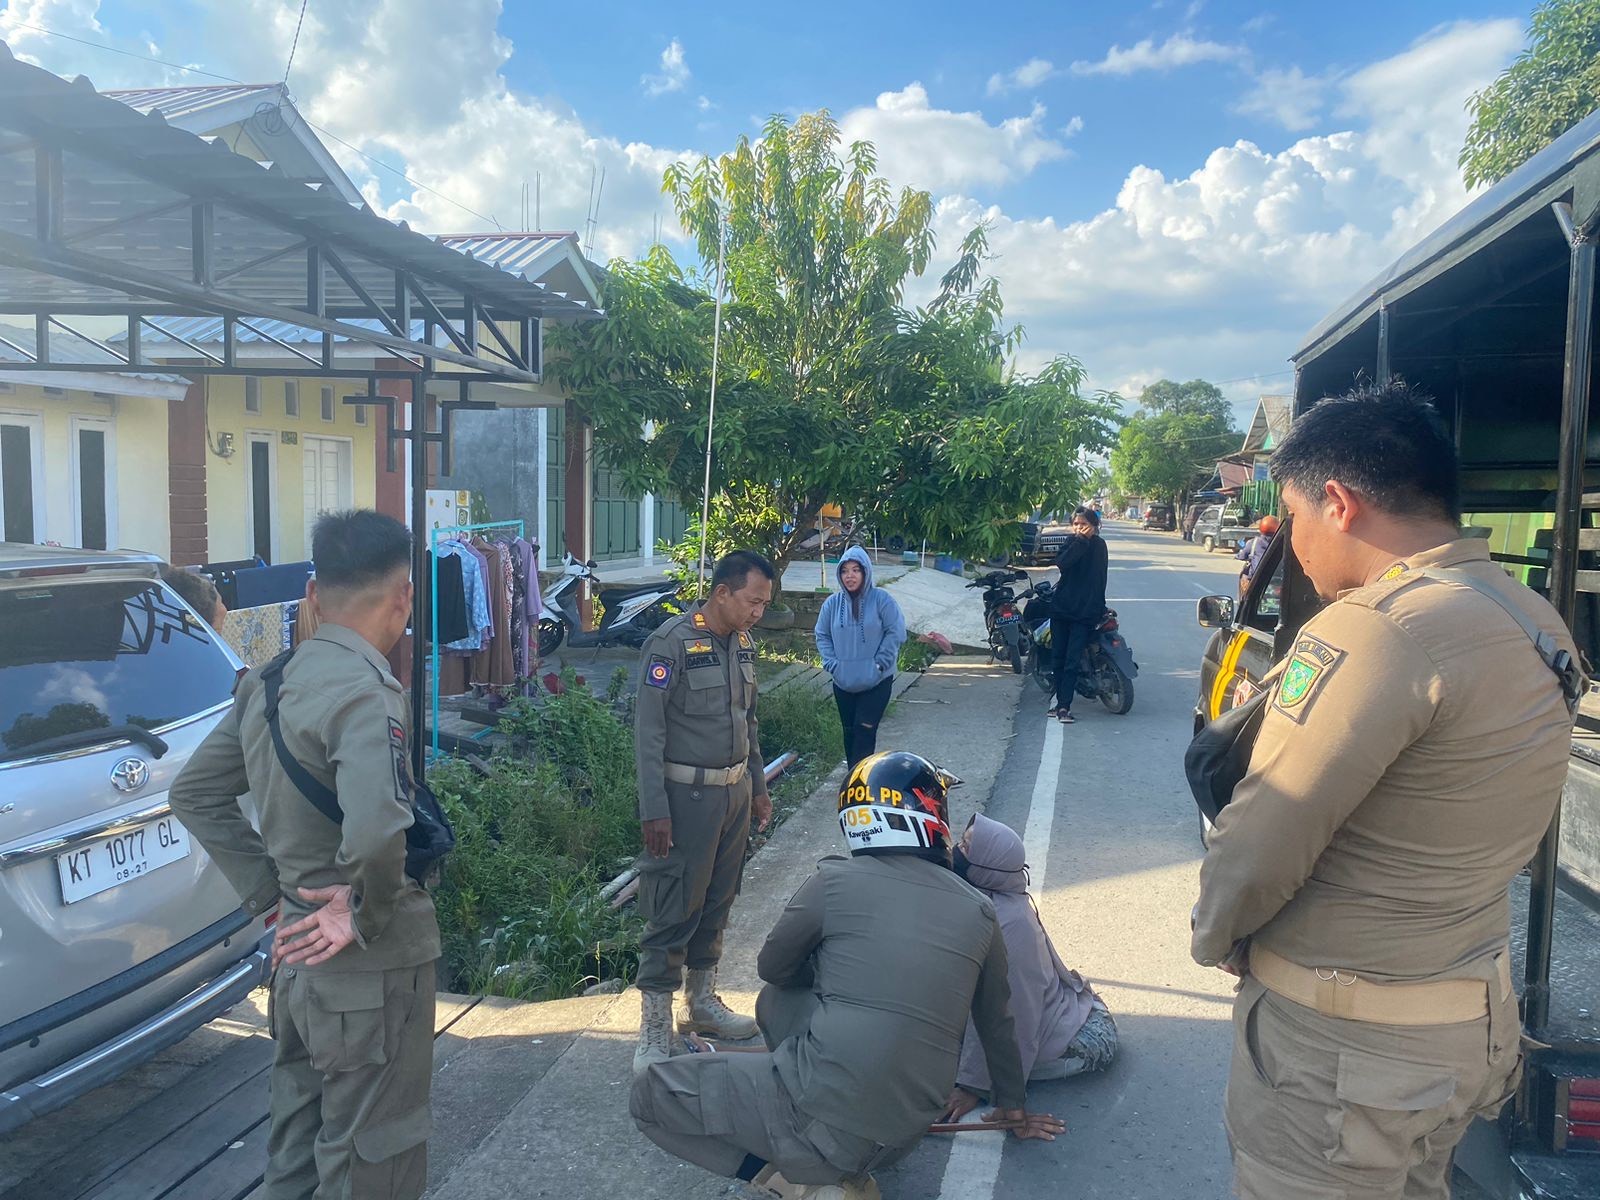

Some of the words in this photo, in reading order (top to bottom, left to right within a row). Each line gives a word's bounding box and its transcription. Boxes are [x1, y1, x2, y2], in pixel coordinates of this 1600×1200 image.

[847, 786, 875, 803] POL
[880, 787, 903, 806] PP
[846, 807, 872, 826] 05
[848, 826, 883, 838] Kawasaki
[68, 848, 92, 884] KT
[105, 828, 145, 869] 1077
[158, 818, 180, 848] GL
